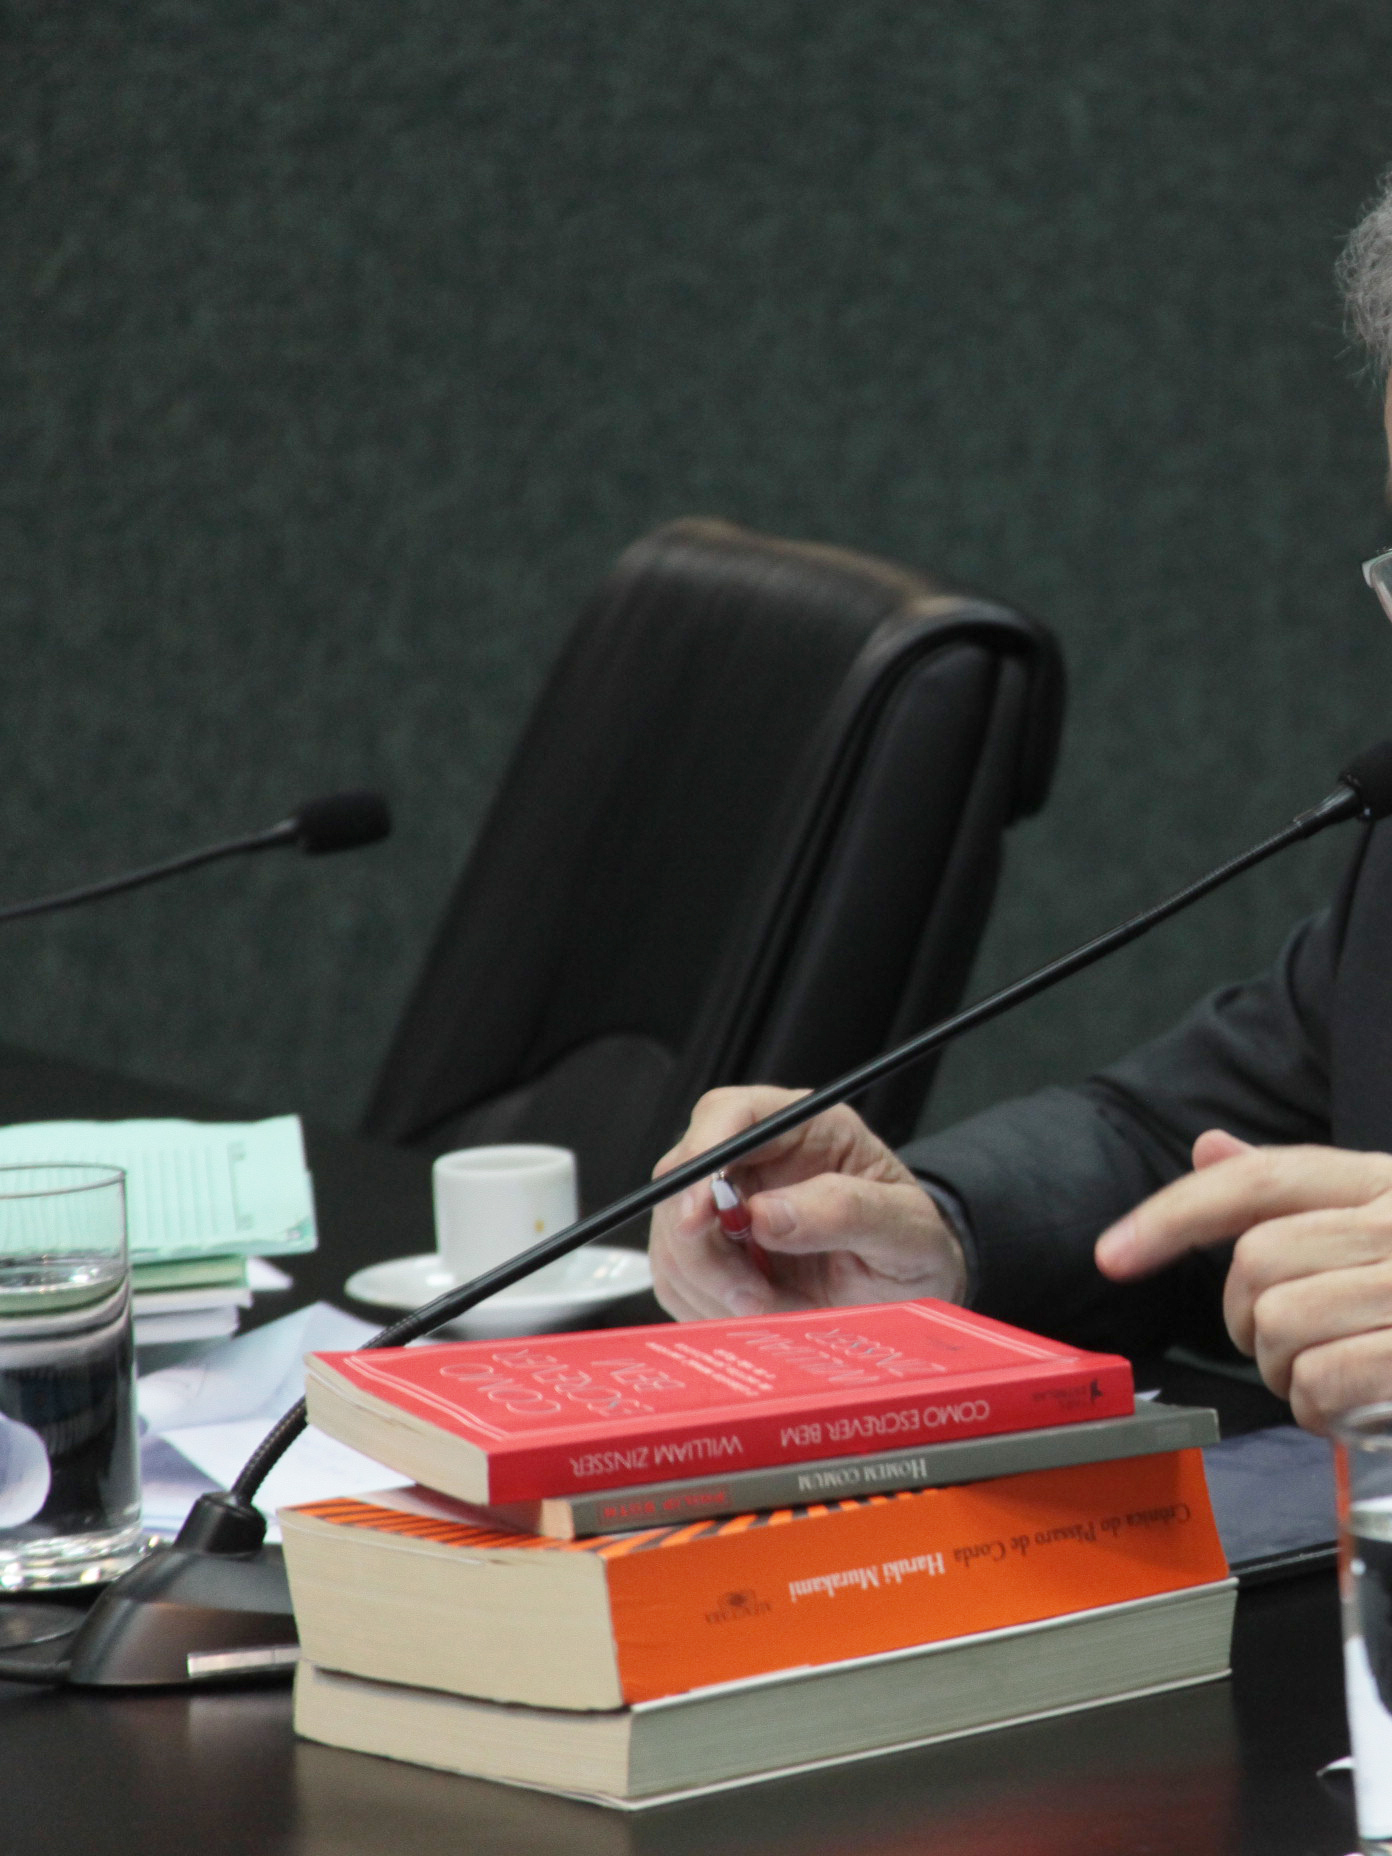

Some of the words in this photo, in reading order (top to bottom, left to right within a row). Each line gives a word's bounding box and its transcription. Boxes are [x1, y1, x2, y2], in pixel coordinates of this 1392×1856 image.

[829, 1411, 920, 1442] ESCREVER
[923, 1399, 991, 1430] COMO
[653, 1434, 743, 1467] WILLIAM
[780, 1427, 823, 1448] BEM
[569, 1446, 650, 1479] ZINSSER
[1101, 1513, 1121, 1537] do
[953, 1543, 1006, 1568] Corda
[1011, 1534, 1030, 1557] de
[881, 1551, 946, 1585] Haruki
[788, 1564, 880, 1604] Murakami
